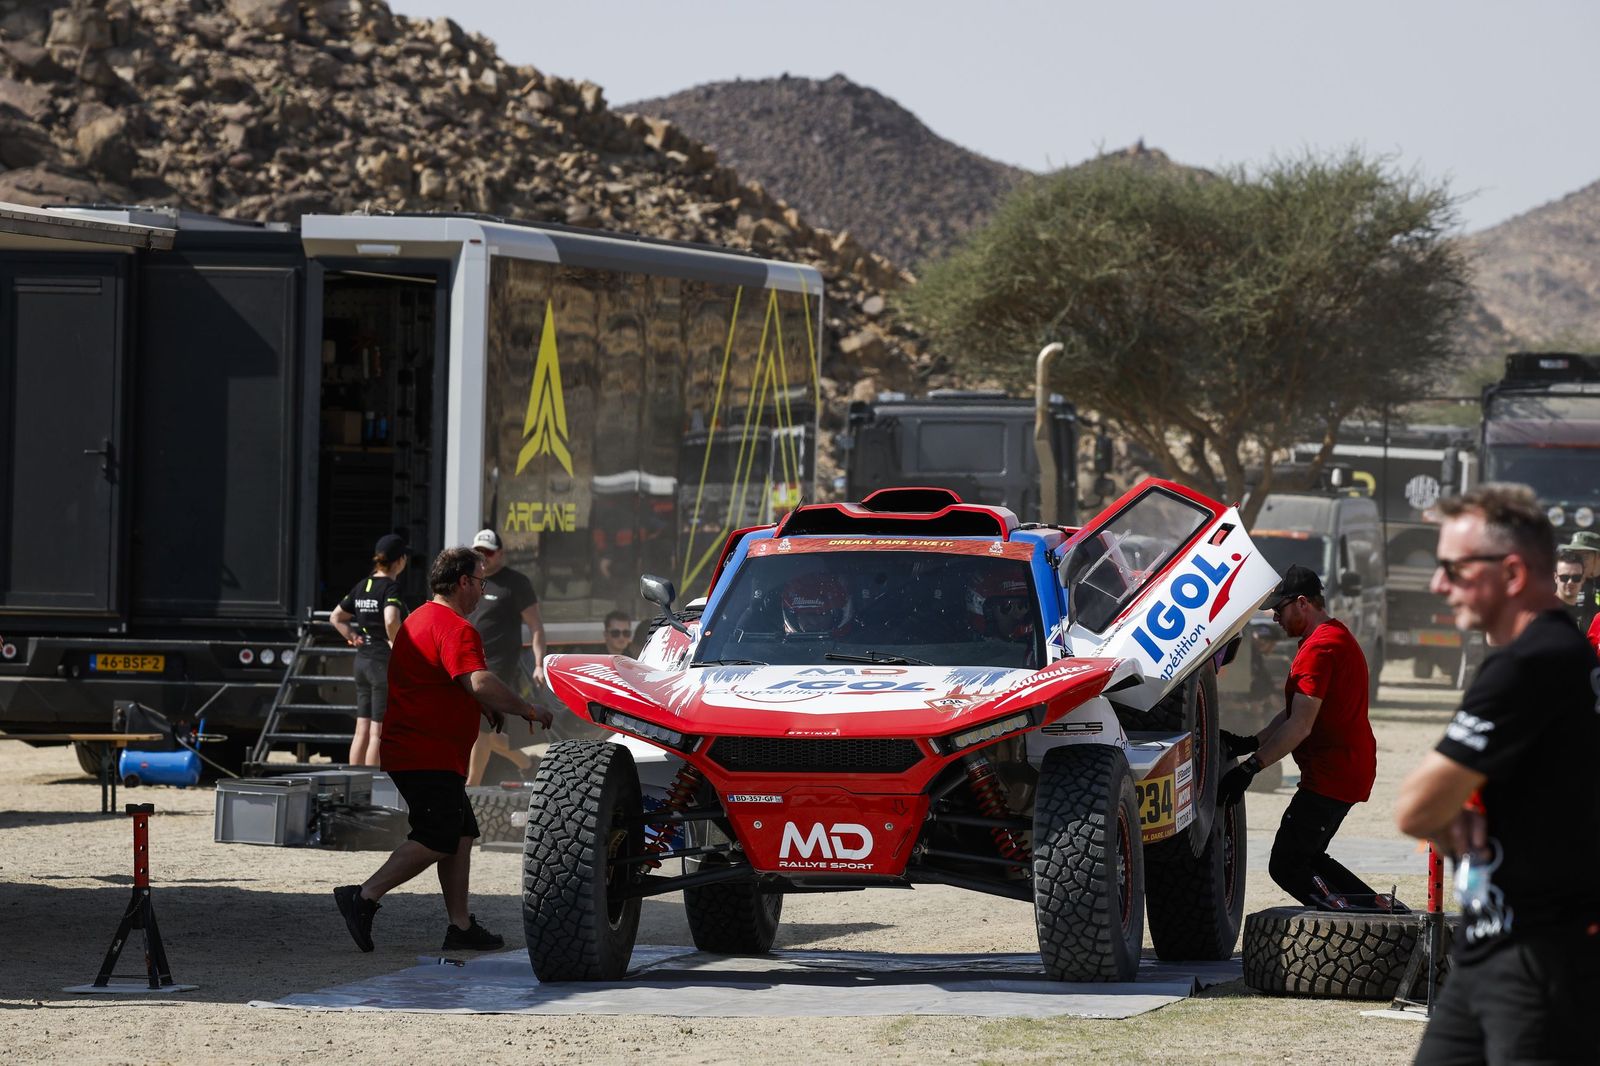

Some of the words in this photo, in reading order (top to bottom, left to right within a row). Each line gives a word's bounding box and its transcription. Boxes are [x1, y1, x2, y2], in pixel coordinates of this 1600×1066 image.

[504, 502, 577, 533] ARCANE
[101, 655, 160, 670] 46-BSF-2
[779, 821, 874, 861] MD
[779, 861, 827, 869] RALLYE
[830, 862, 875, 870] SPORT
